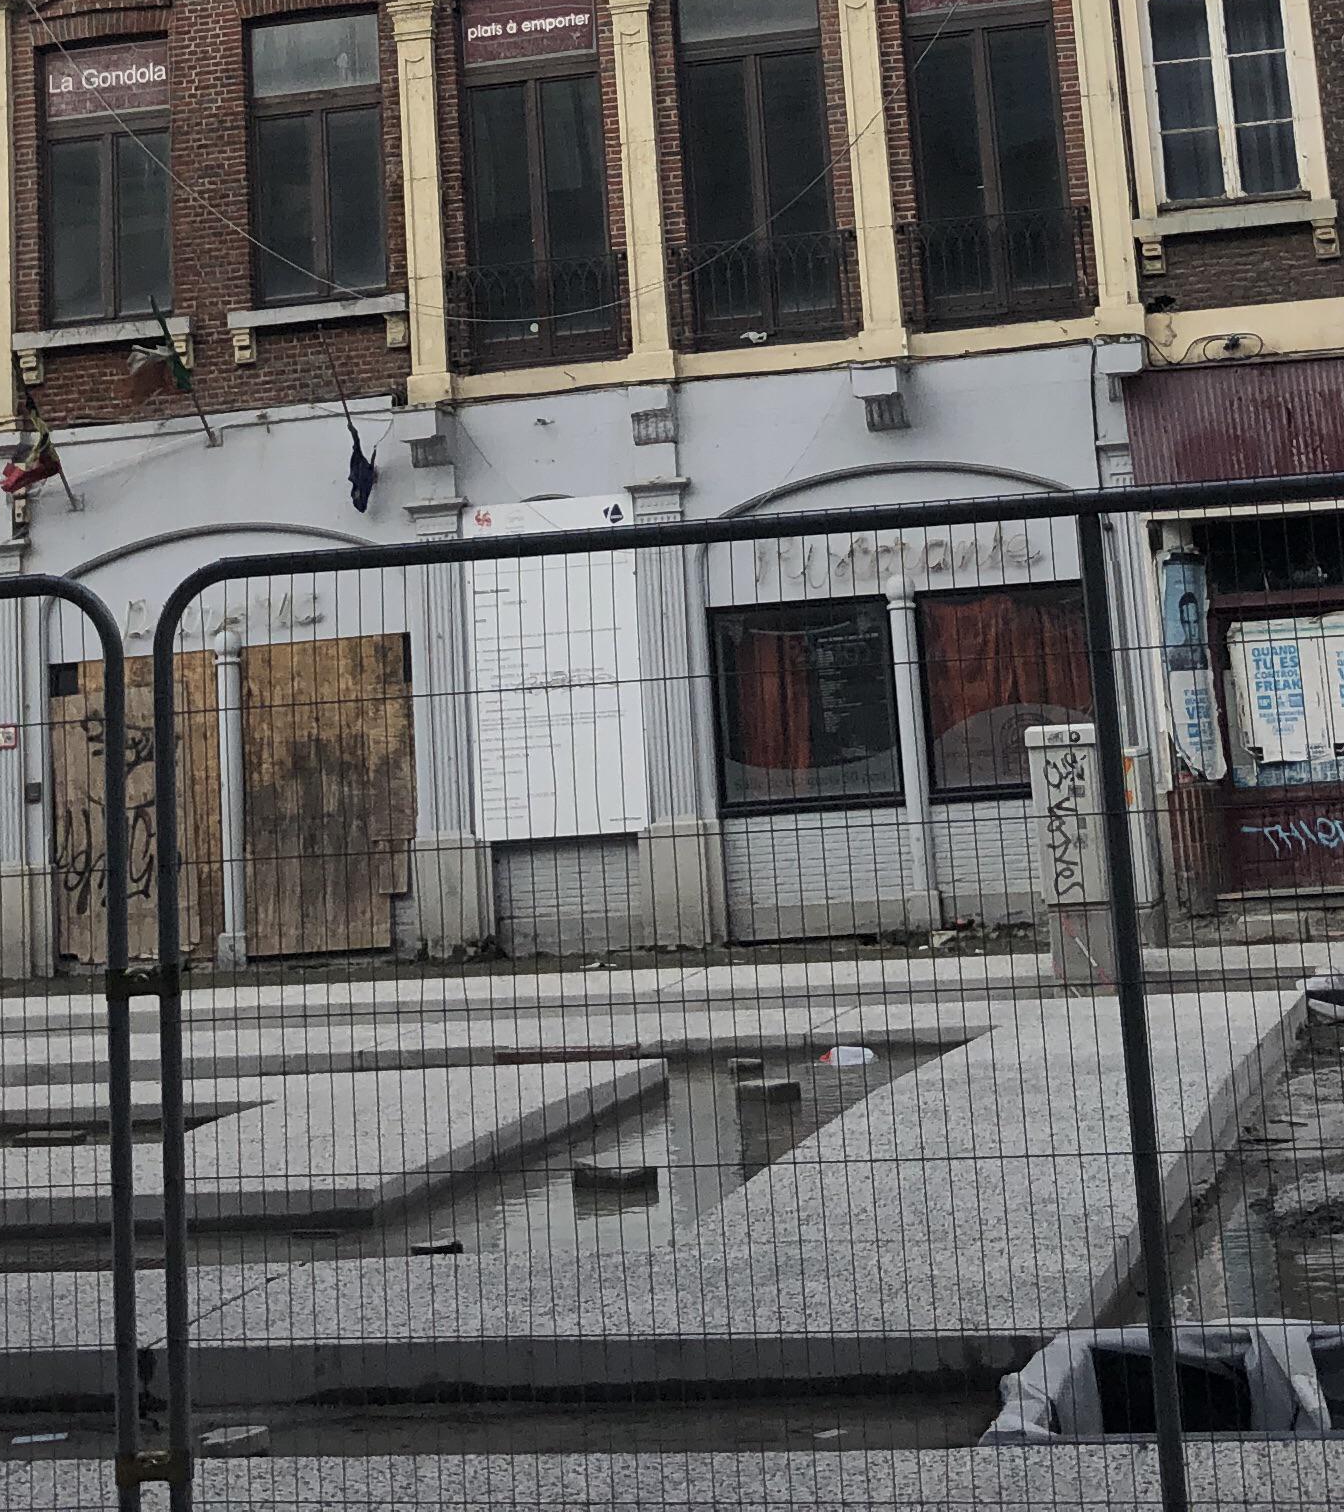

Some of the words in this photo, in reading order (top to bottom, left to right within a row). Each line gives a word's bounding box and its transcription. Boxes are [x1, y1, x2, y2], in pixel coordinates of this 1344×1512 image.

[467, 22, 503, 42] plats
[506, 19, 517, 34] à
[521, 12, 590, 33] emporter
[48, 74, 73, 94] La
[81, 62, 167, 89] Gondola
[1251, 644, 1297, 658] QUAND
[1253, 657, 1275, 671] TU
[1279, 655, 1299, 668] ES
[1255, 678, 1303, 692] FREAK
